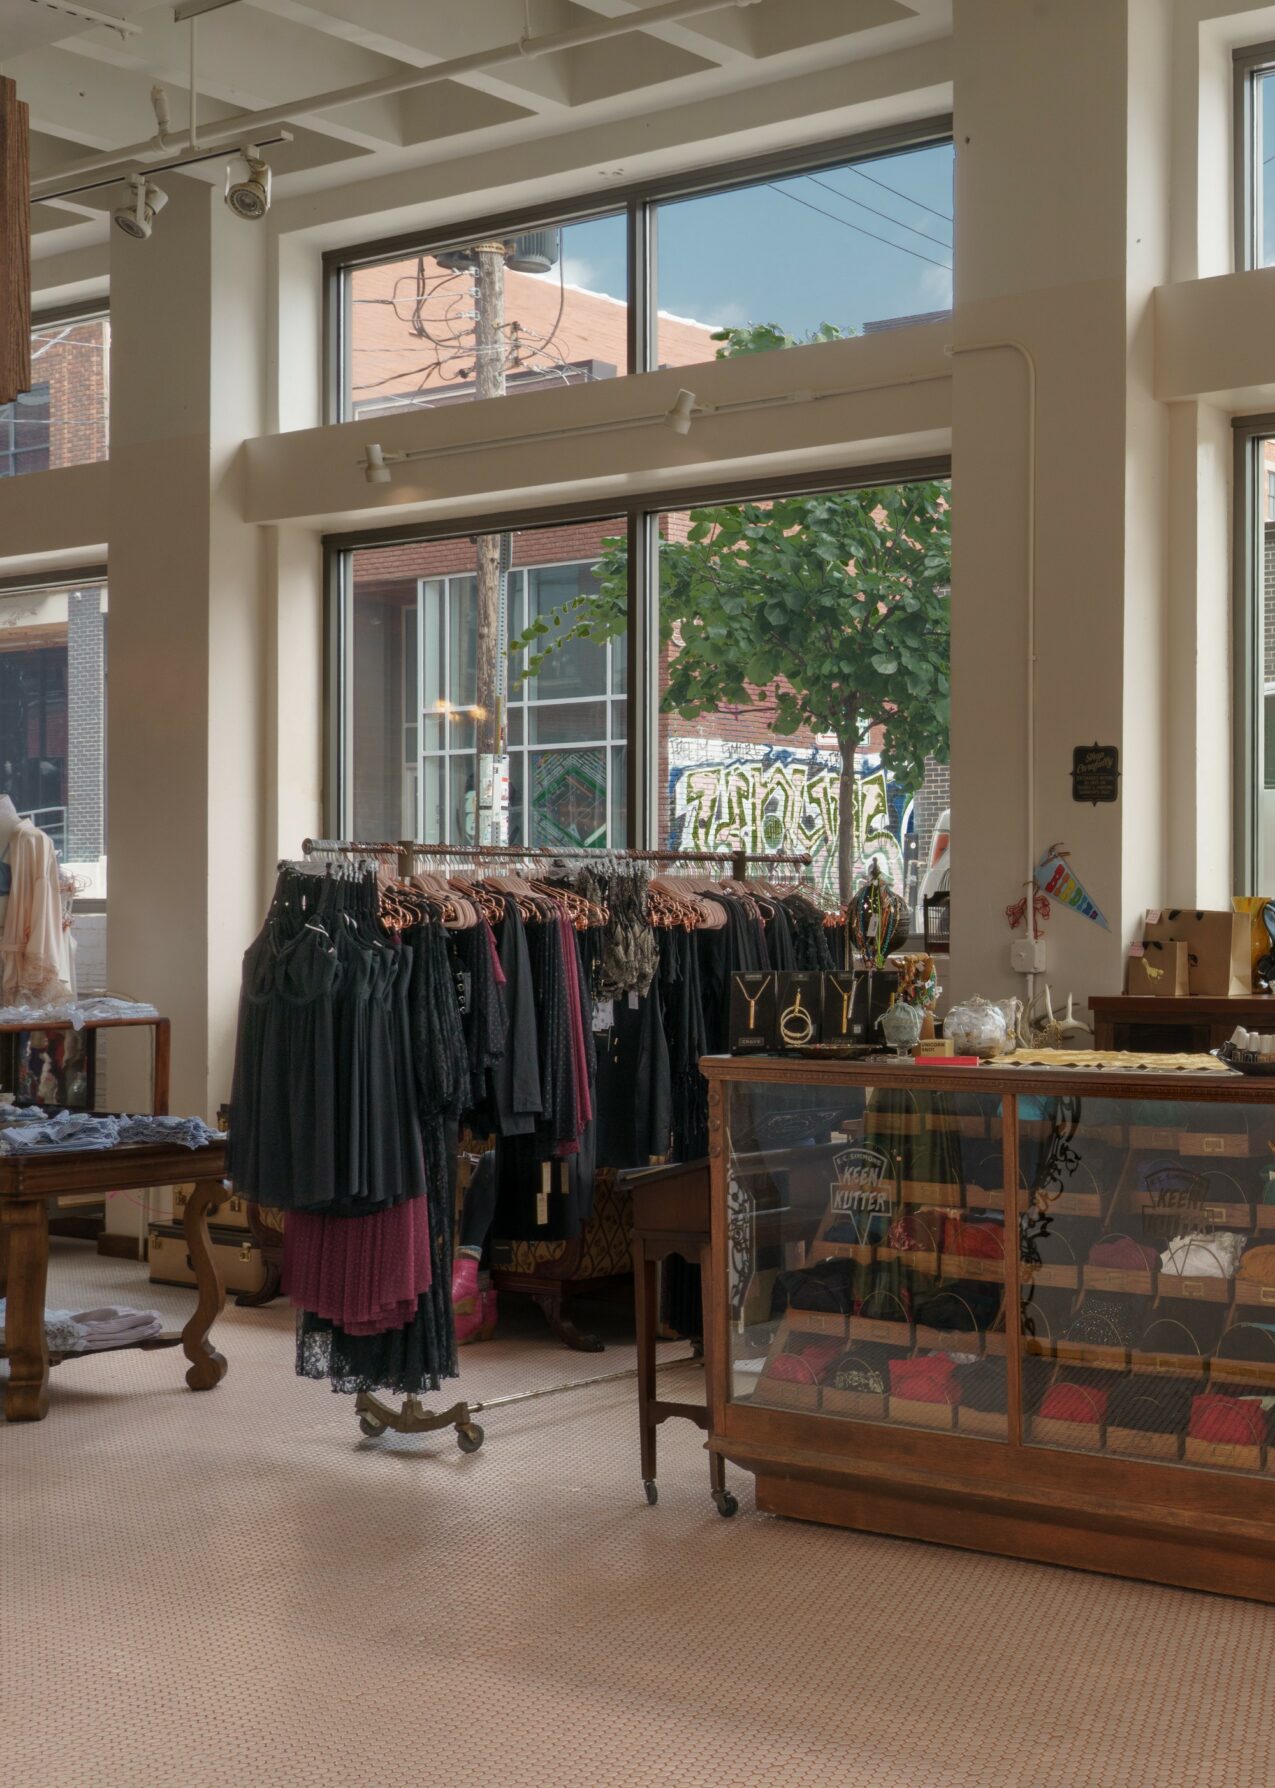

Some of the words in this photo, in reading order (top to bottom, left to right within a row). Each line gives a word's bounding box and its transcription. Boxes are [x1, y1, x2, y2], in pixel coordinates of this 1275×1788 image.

[1045, 864, 1098, 920] BIRDIES
[842, 1166, 879, 1187] KEEN
[834, 1190, 888, 1212] KUTTER
[1157, 1188, 1201, 1210] KEEN
